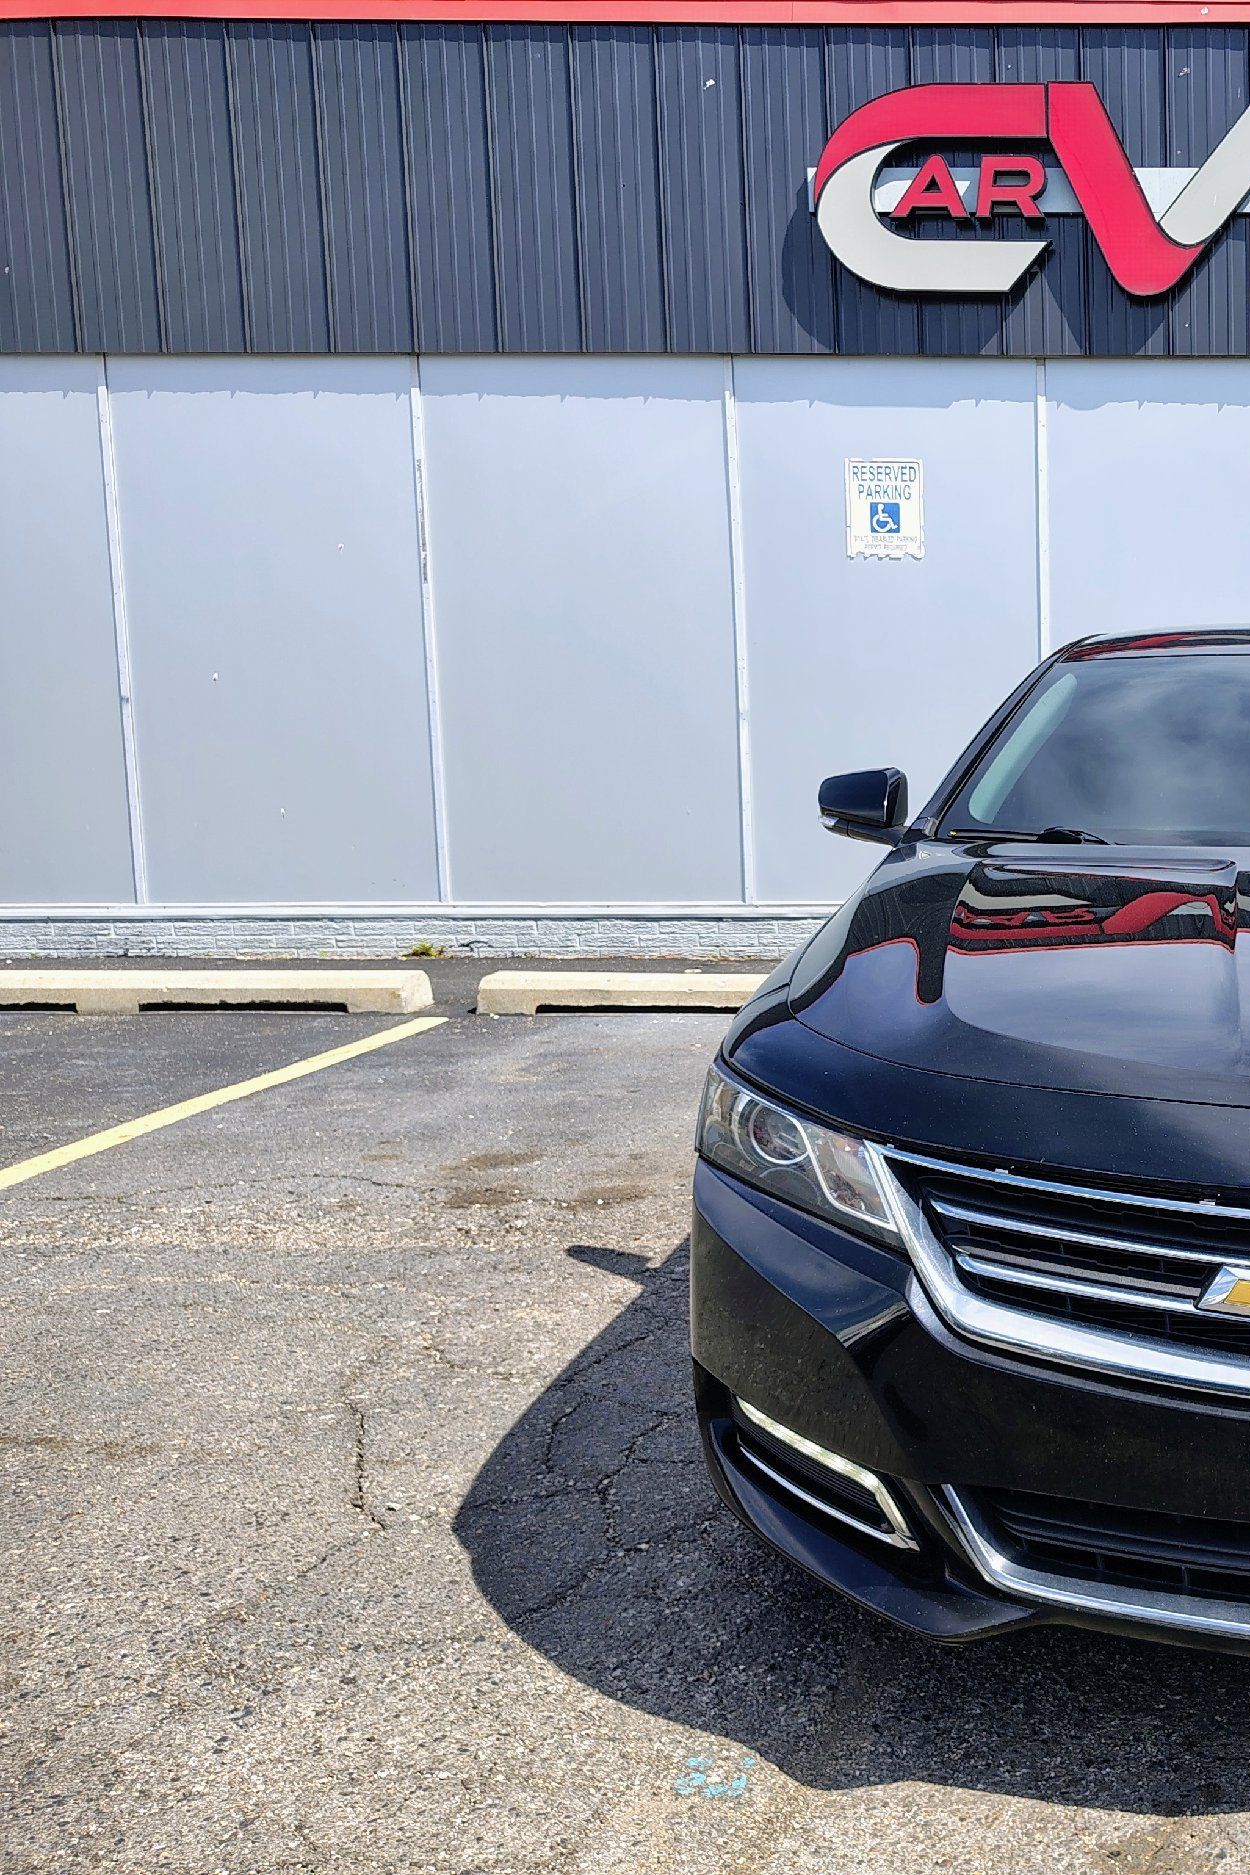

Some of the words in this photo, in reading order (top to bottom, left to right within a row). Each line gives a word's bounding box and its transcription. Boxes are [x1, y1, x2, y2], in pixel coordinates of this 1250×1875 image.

[813, 82, 1053, 294] CAR
[852, 465, 917, 483] RESERVED
[857, 484, 912, 501] PARKING
